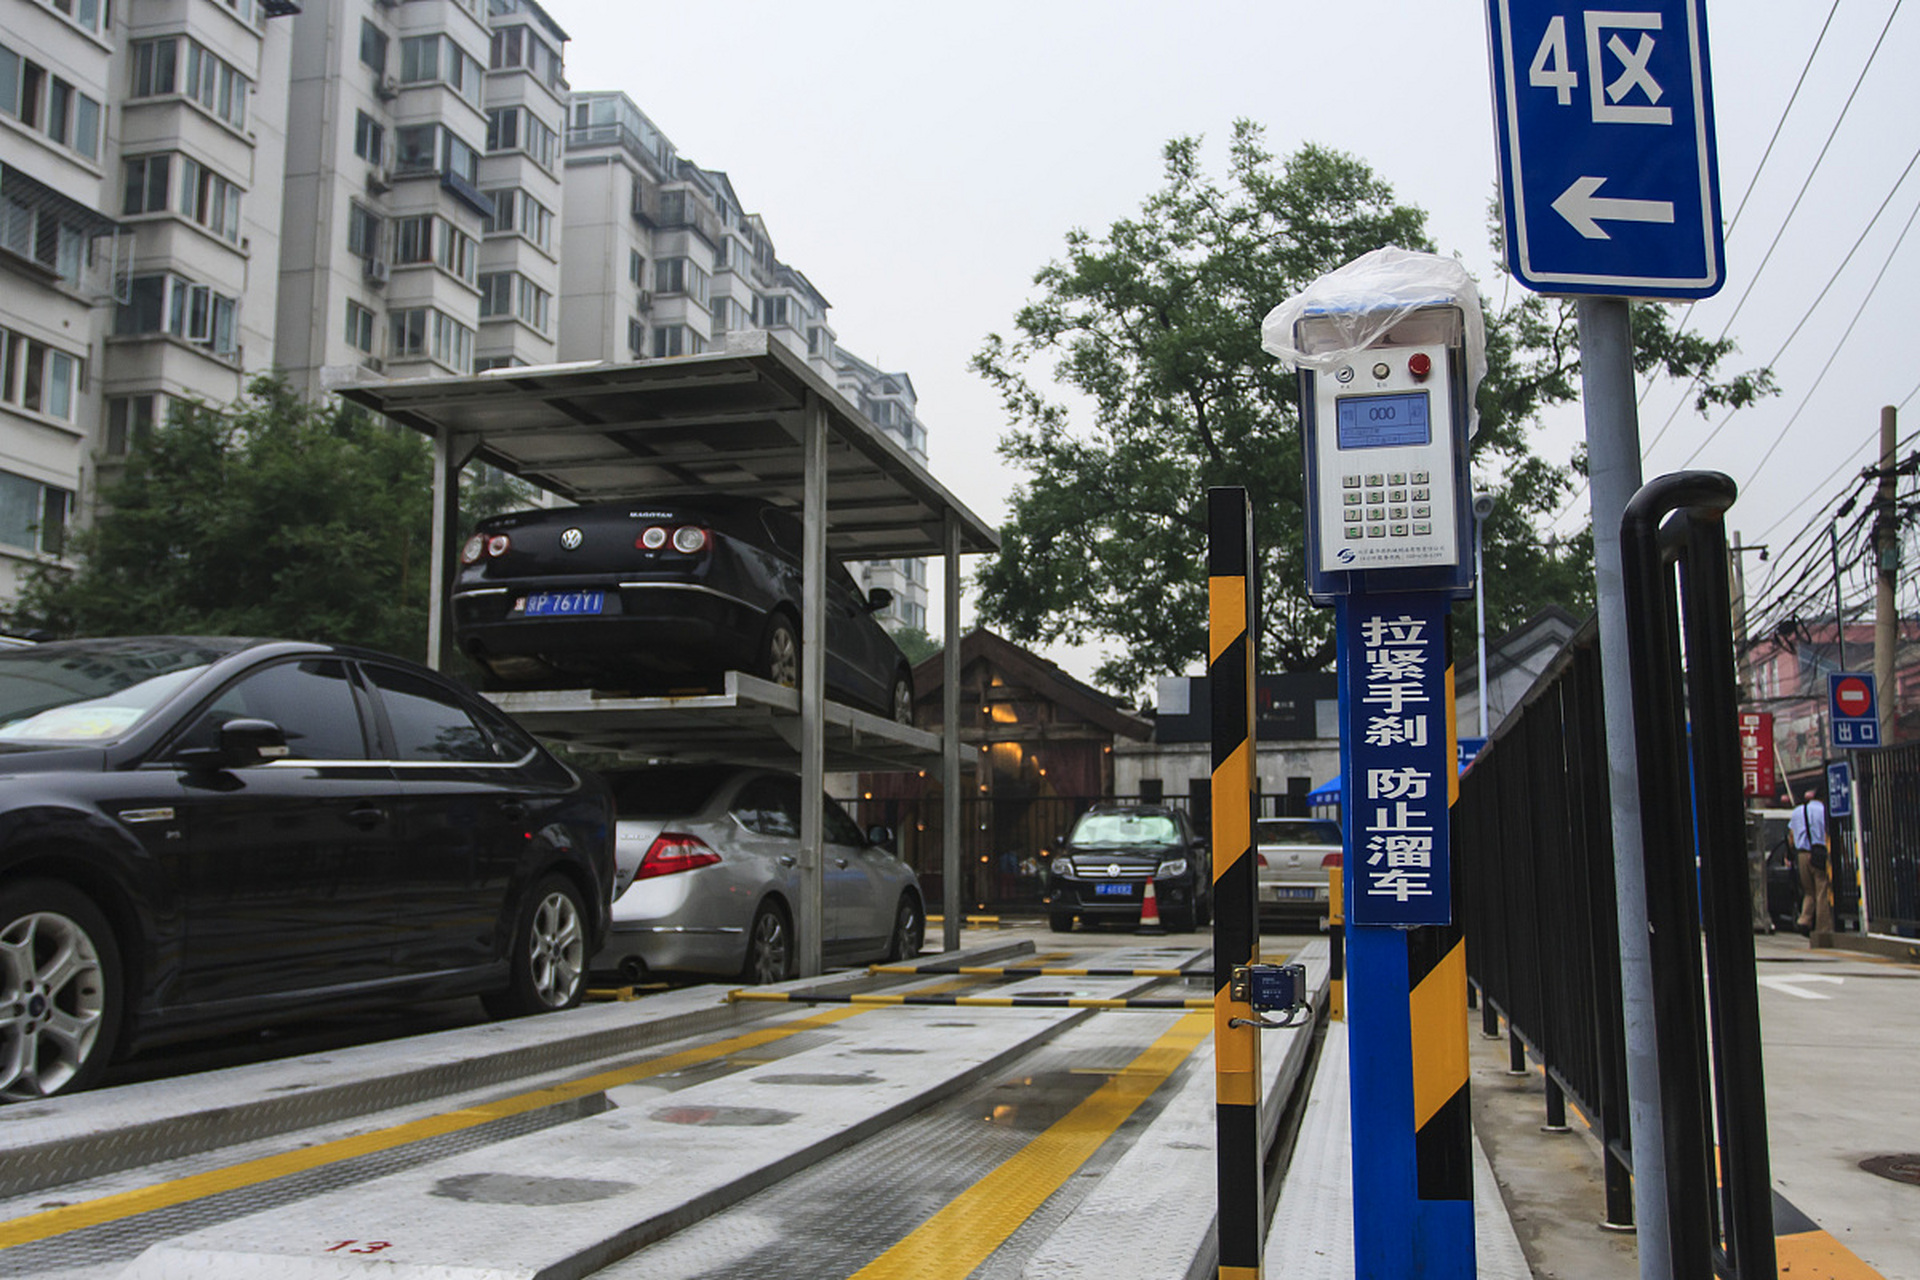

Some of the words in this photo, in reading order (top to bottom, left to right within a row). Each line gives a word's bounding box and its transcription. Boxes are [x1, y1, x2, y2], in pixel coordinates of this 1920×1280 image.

[1529, 10, 1673, 125] 4区
[1361, 615, 1430, 747] 拉紧手刹
[1838, 722, 1874, 742] 出口
[1366, 767, 1434, 902] 防止溜车
